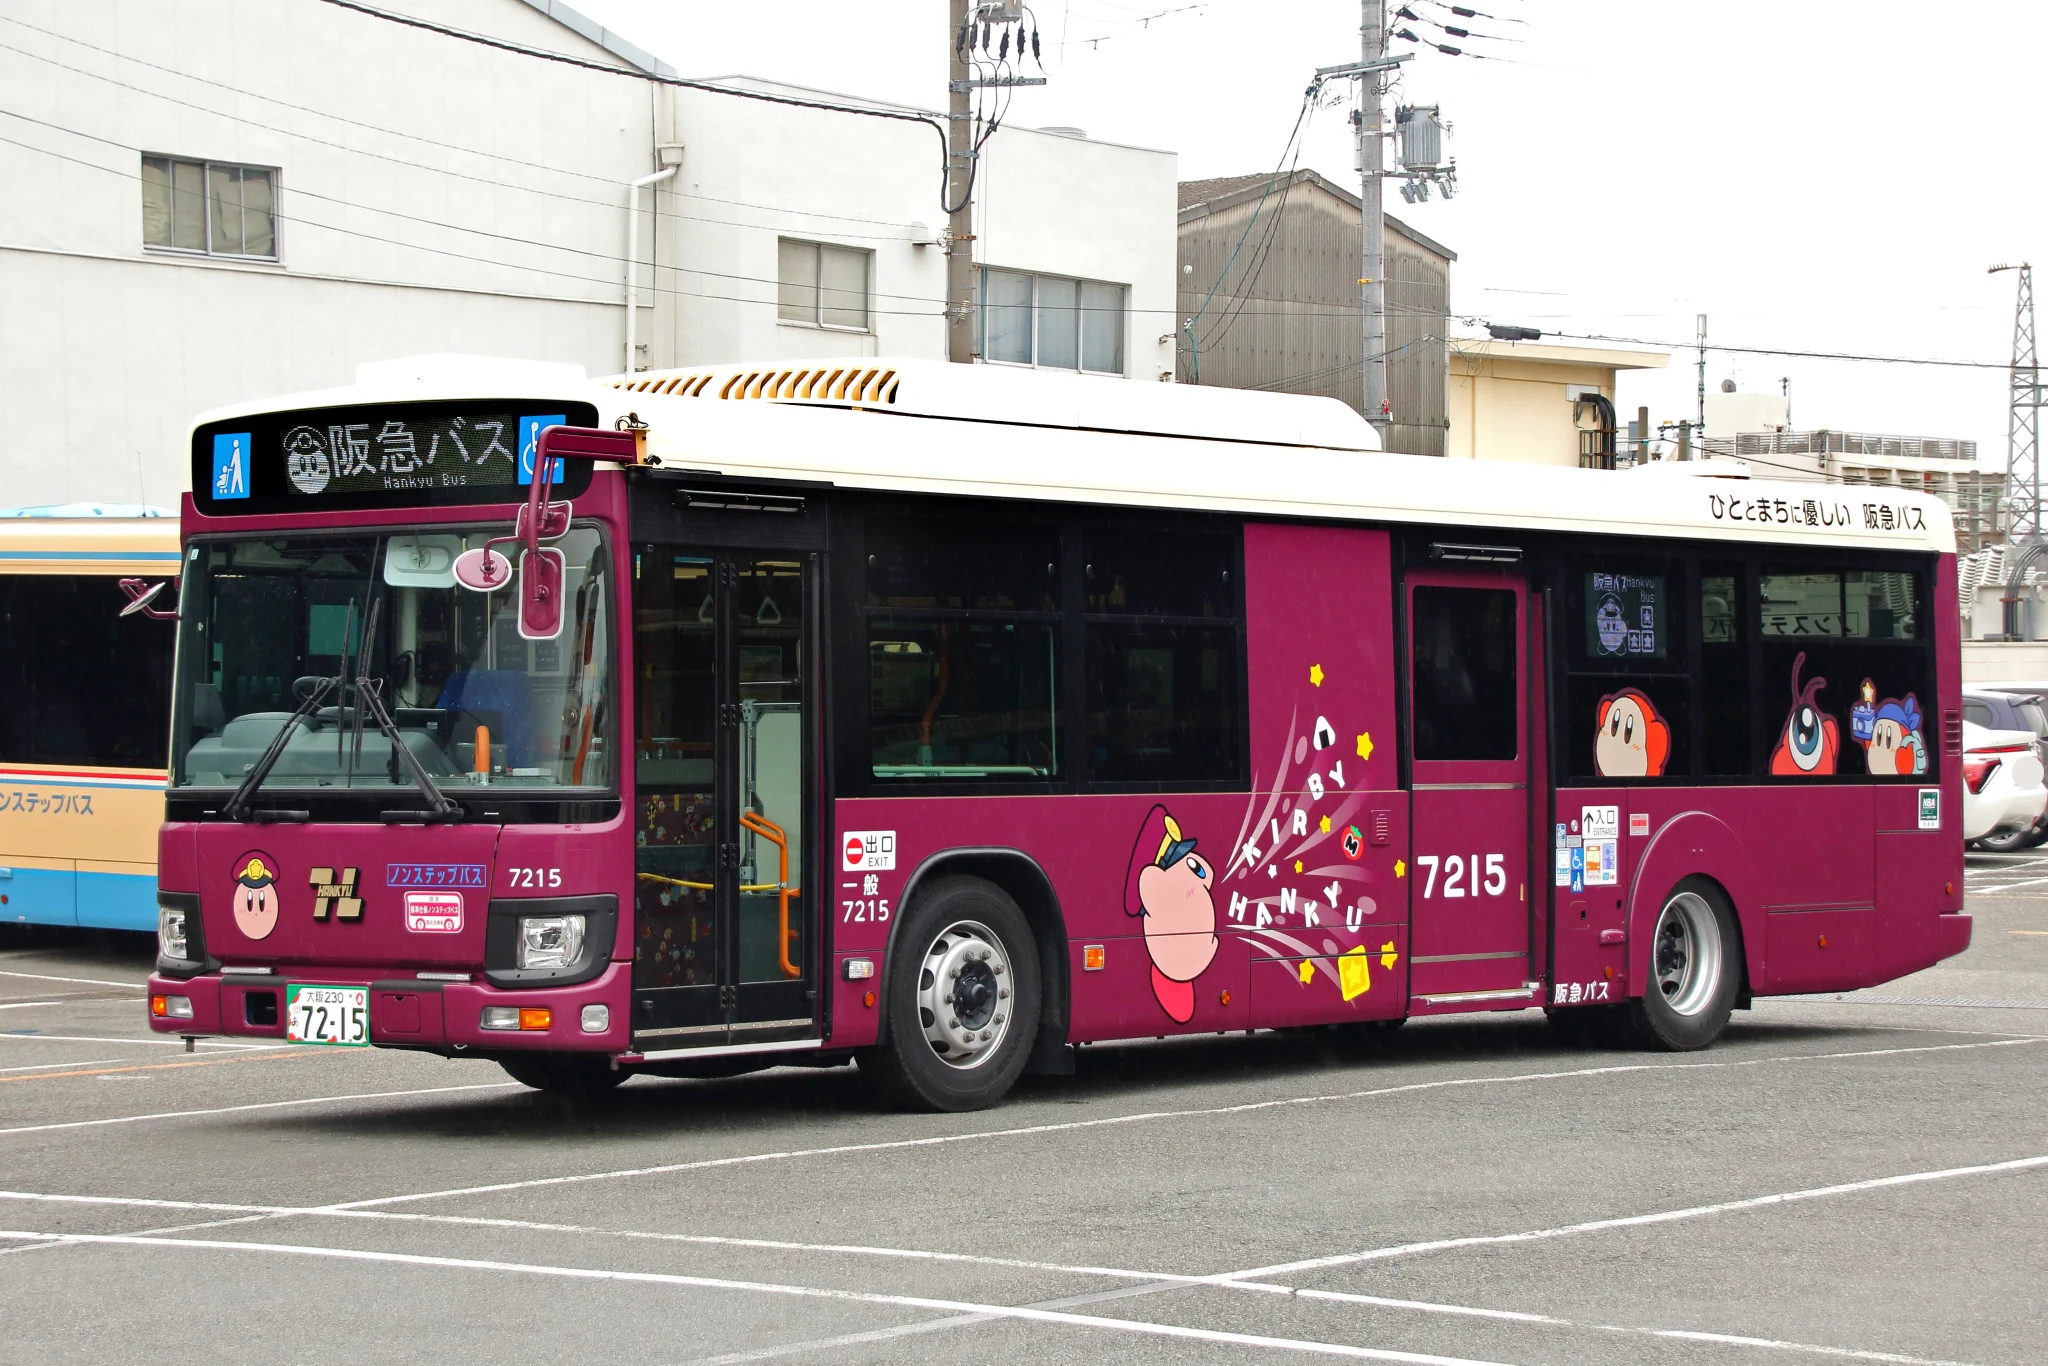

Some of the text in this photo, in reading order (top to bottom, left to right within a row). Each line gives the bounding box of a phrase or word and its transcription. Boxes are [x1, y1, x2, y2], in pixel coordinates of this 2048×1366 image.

[328, 416, 514, 478] 阪急バス
[384, 473, 467, 489] Hankyu Bus
[1709, 493, 1928, 531] ひととまちに優しい 阪急バス
[1593, 573, 1627, 592] 阪急バス
[1640, 589, 1655, 603] Bus
[1922, 798, 1936, 807] NBA
[1240, 760, 1346, 868] KIRBY
[1595, 809, 1615, 825] 入口
[1593, 827, 1618, 837] ENTRANCE
[865, 834, 893, 854] 出口
[868, 856, 889, 867] EXIT
[390, 866, 482, 884] ノンステップバス
[508, 868, 562, 888] 7215
[842, 873, 879, 896] 一般
[1417, 853, 1507, 899] 7215
[317, 884, 353, 897] HANKYU
[842, 899, 889, 923] 7215
[1228, 880, 1362, 933] HANKYU
[306, 991, 344, 1004] 大阪 230
[1554, 980, 1609, 1004] 阪急バス
[291, 1016, 299, 1027] あ
